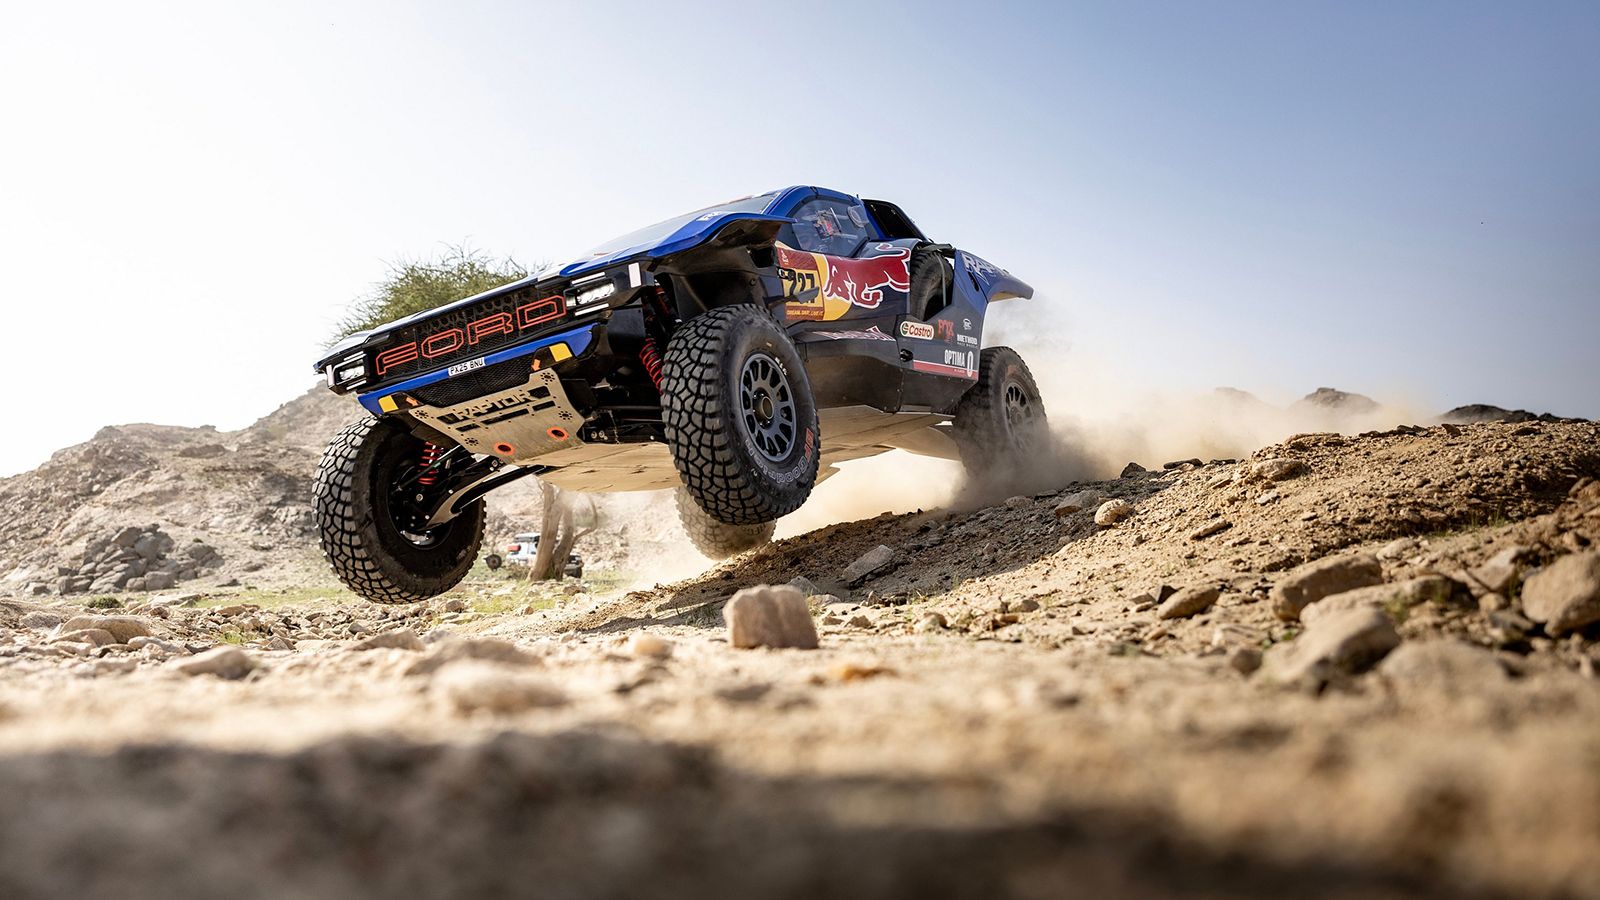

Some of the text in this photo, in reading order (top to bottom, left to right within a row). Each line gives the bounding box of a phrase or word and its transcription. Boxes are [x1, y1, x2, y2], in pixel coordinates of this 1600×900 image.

[376, 295, 567, 375] FORD
[909, 325, 933, 338] Castrol
[957, 334, 977, 345] METHOD
[450, 357, 483, 375] PX25 BNU
[944, 349, 966, 367] OPTIMA
[454, 391, 534, 420] RAPTOR
